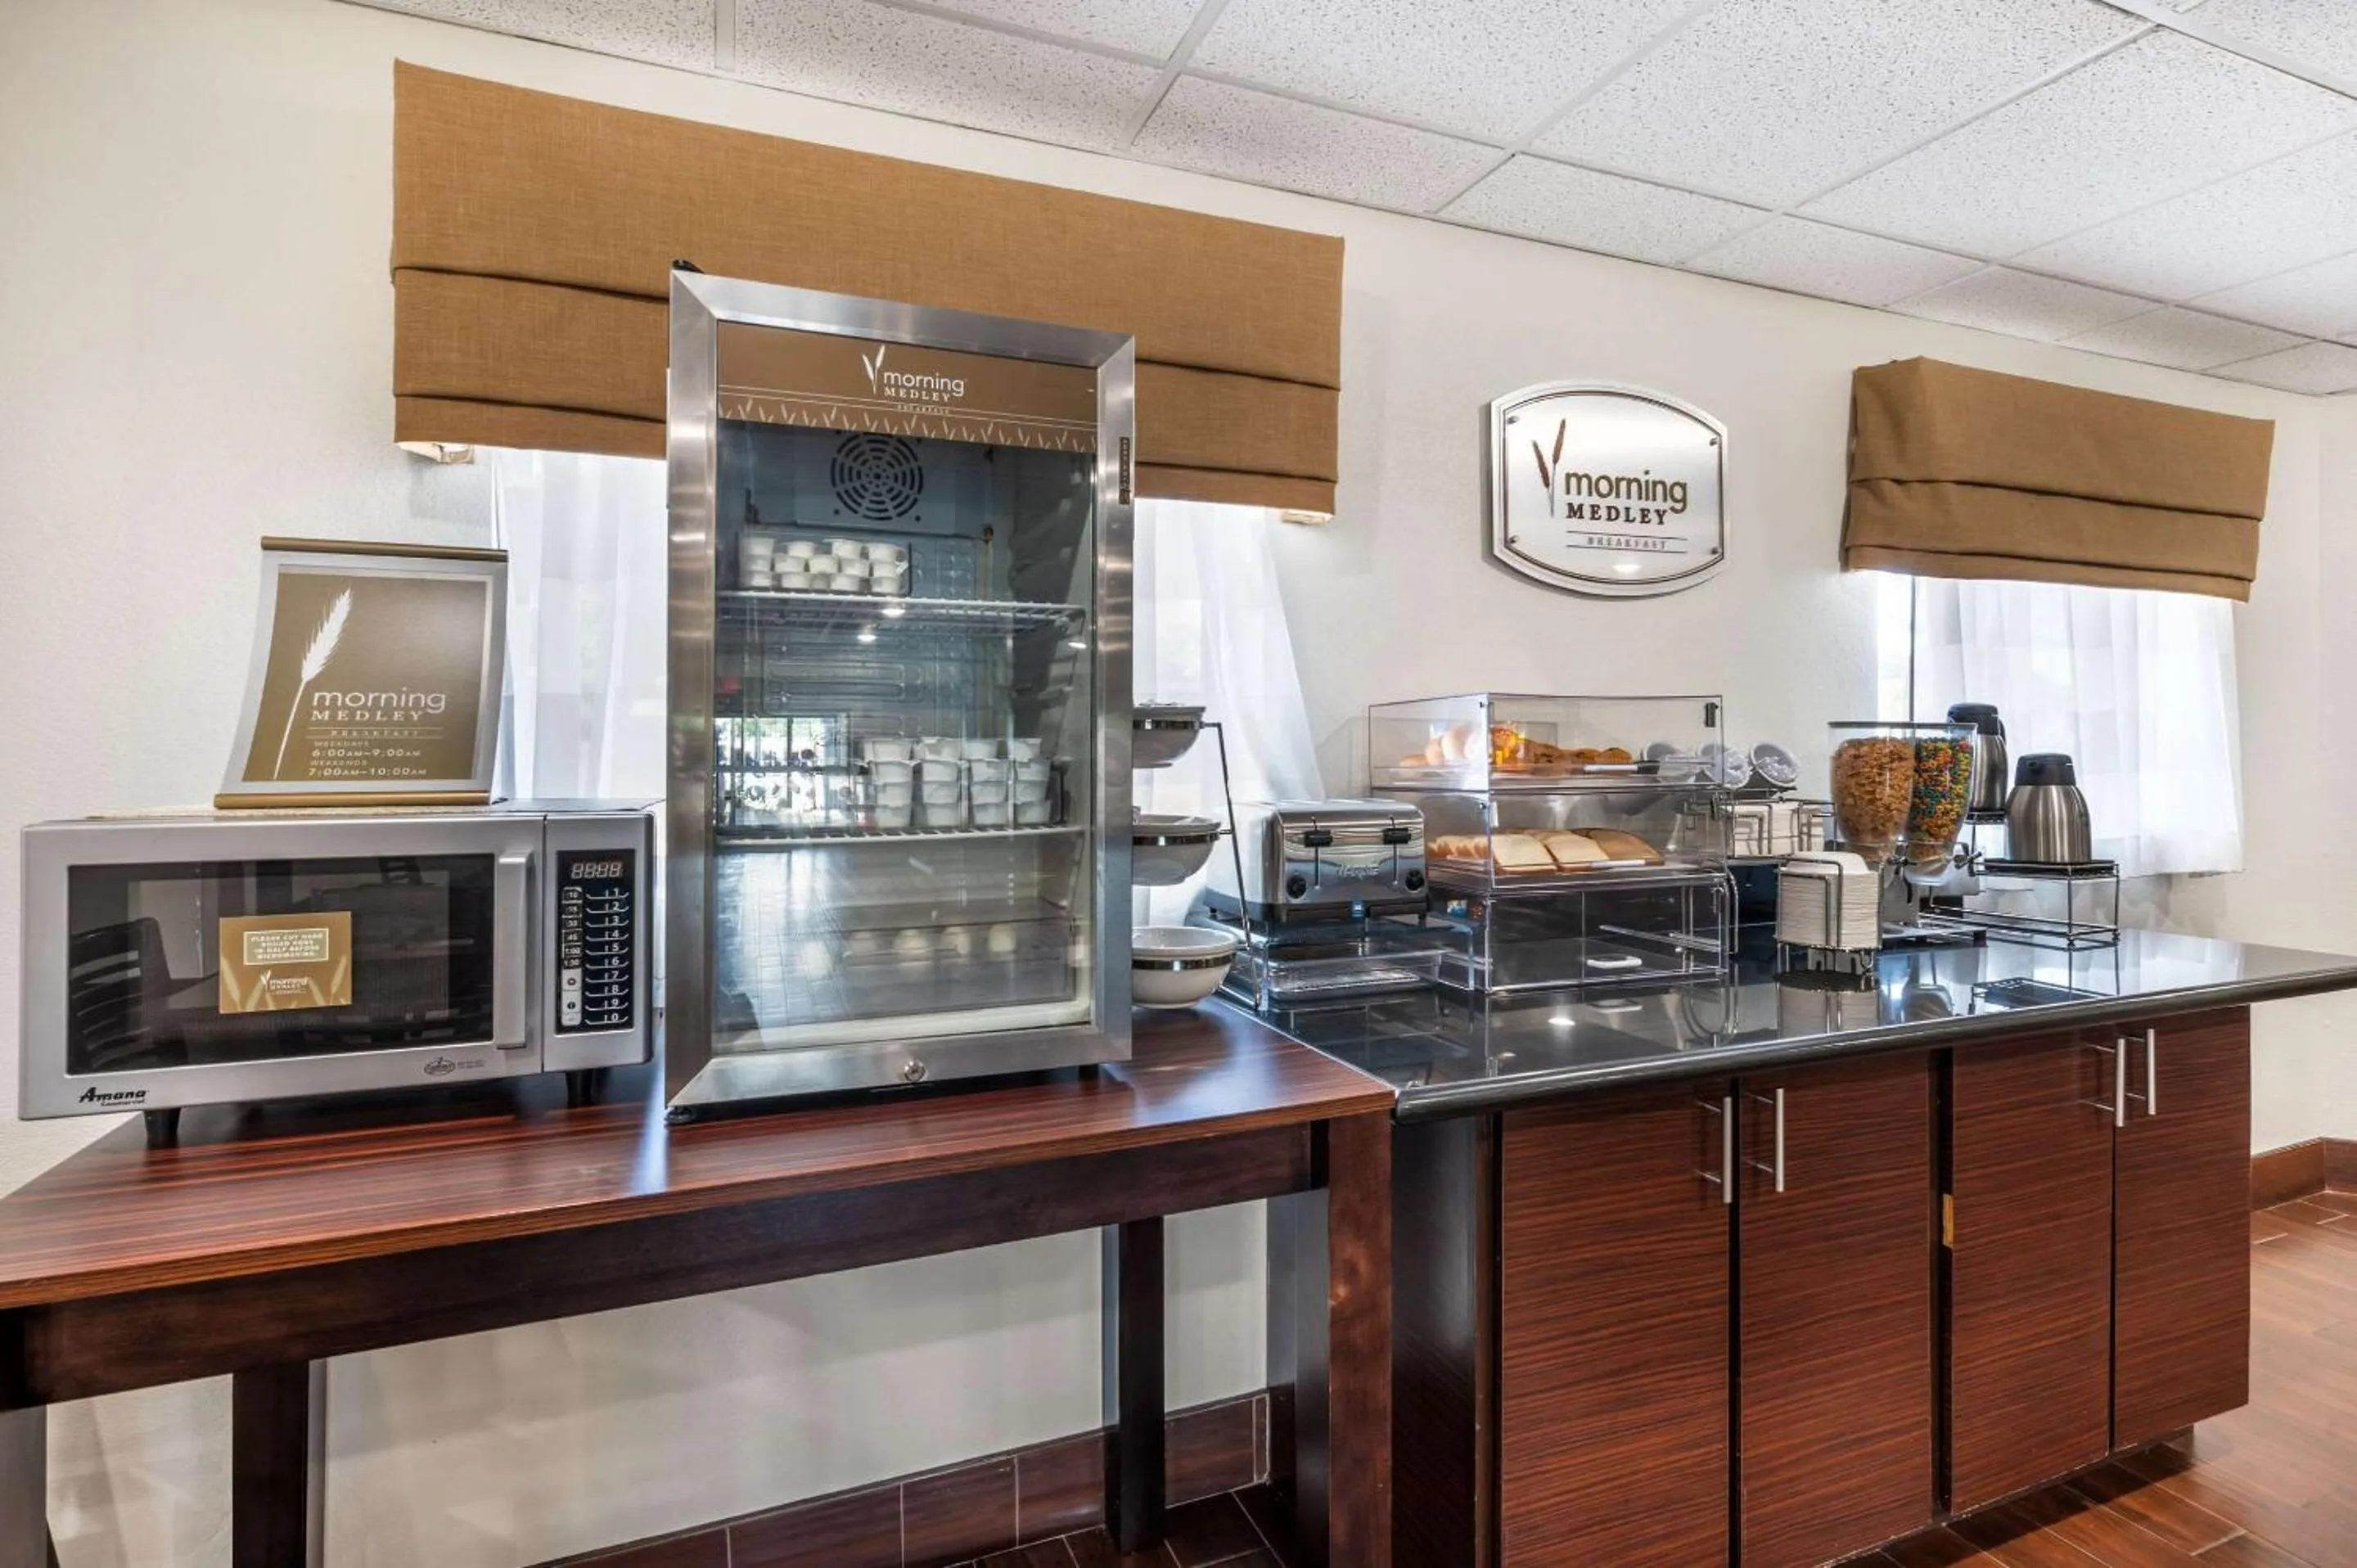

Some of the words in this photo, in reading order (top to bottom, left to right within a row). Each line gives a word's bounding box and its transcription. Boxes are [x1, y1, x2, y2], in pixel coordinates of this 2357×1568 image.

[883, 372, 964, 397] morning
[884, 386, 951, 403] MEDLEY
[1565, 470, 1688, 514] morning
[1566, 502, 1668, 525] MEDLEY
[1586, 537, 1668, 550] BREAKFAST
[313, 687, 445, 714] morning
[311, 710, 423, 721] MEDLEY
[613, 887, 620, 897] 1
[612, 901, 620, 911] 2
[612, 915, 620, 924] 3
[612, 930, 620, 939] 4
[612, 943, 619, 952] 5
[611, 957, 620, 966] 6
[612, 971, 619, 980] 7
[612, 985, 619, 993] 8
[611, 998, 619, 1007] 9
[611, 1012, 619, 1021] 0
[79, 1087, 146, 1103] Amana
